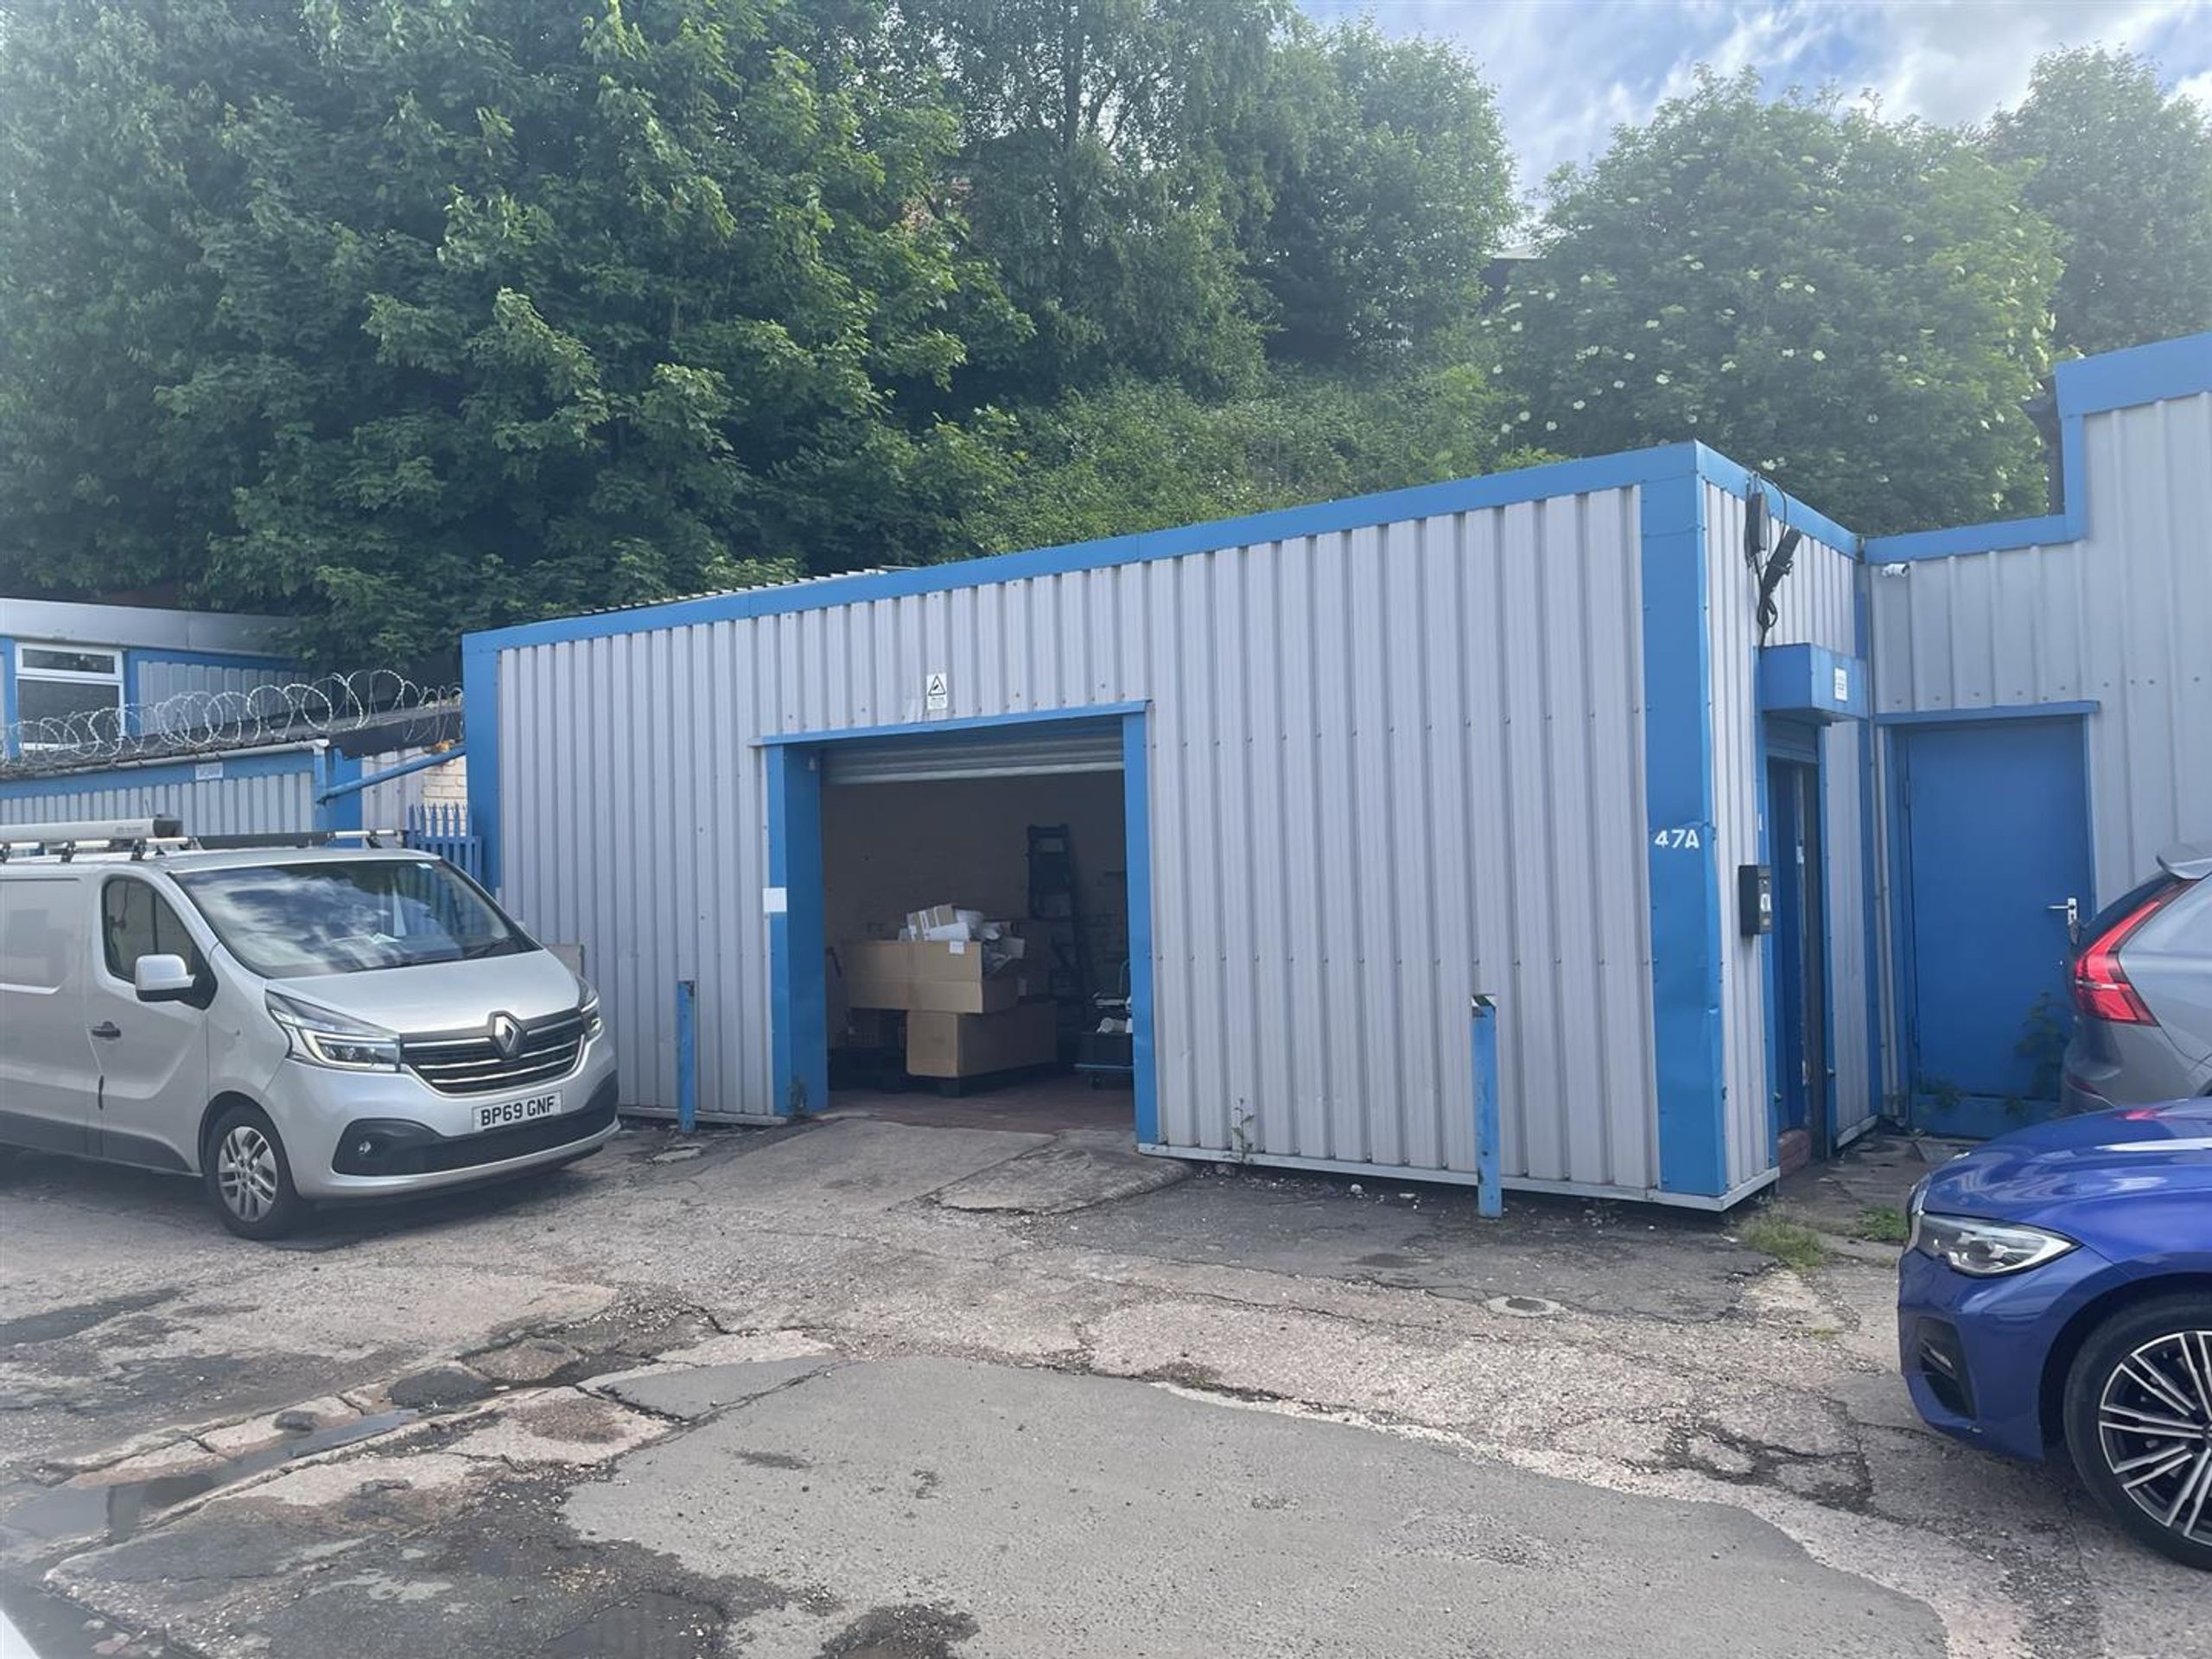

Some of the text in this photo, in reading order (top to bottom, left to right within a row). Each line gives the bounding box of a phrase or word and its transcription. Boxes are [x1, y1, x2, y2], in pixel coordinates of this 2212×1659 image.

[1654, 829, 1700, 849] 47A
[480, 1096, 556, 1127] BP69 GNF
